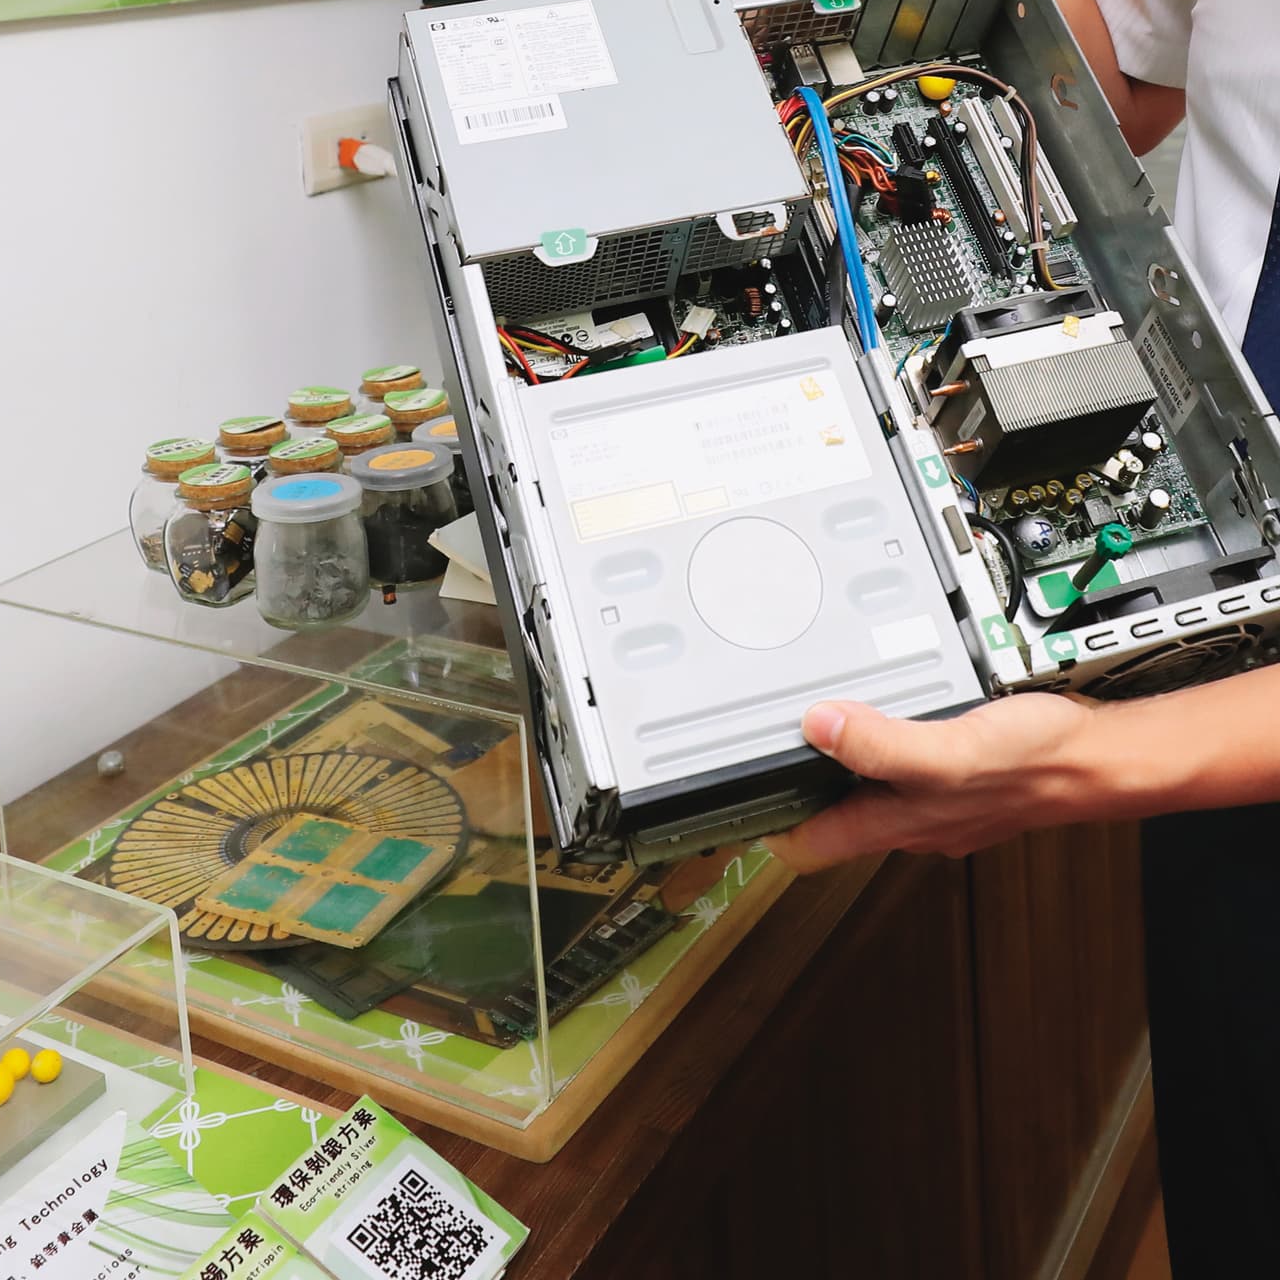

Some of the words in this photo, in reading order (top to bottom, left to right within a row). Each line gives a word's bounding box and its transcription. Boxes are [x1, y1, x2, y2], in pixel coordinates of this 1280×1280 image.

[18, 1157, 109, 1233] Technology
[271, 1107, 376, 1208] 環保剝銀方案
[299, 1161, 353, 1213] Eco-friendly
[350, 1135, 377, 1162] Silver
[334, 1160, 373, 1199] stripping
